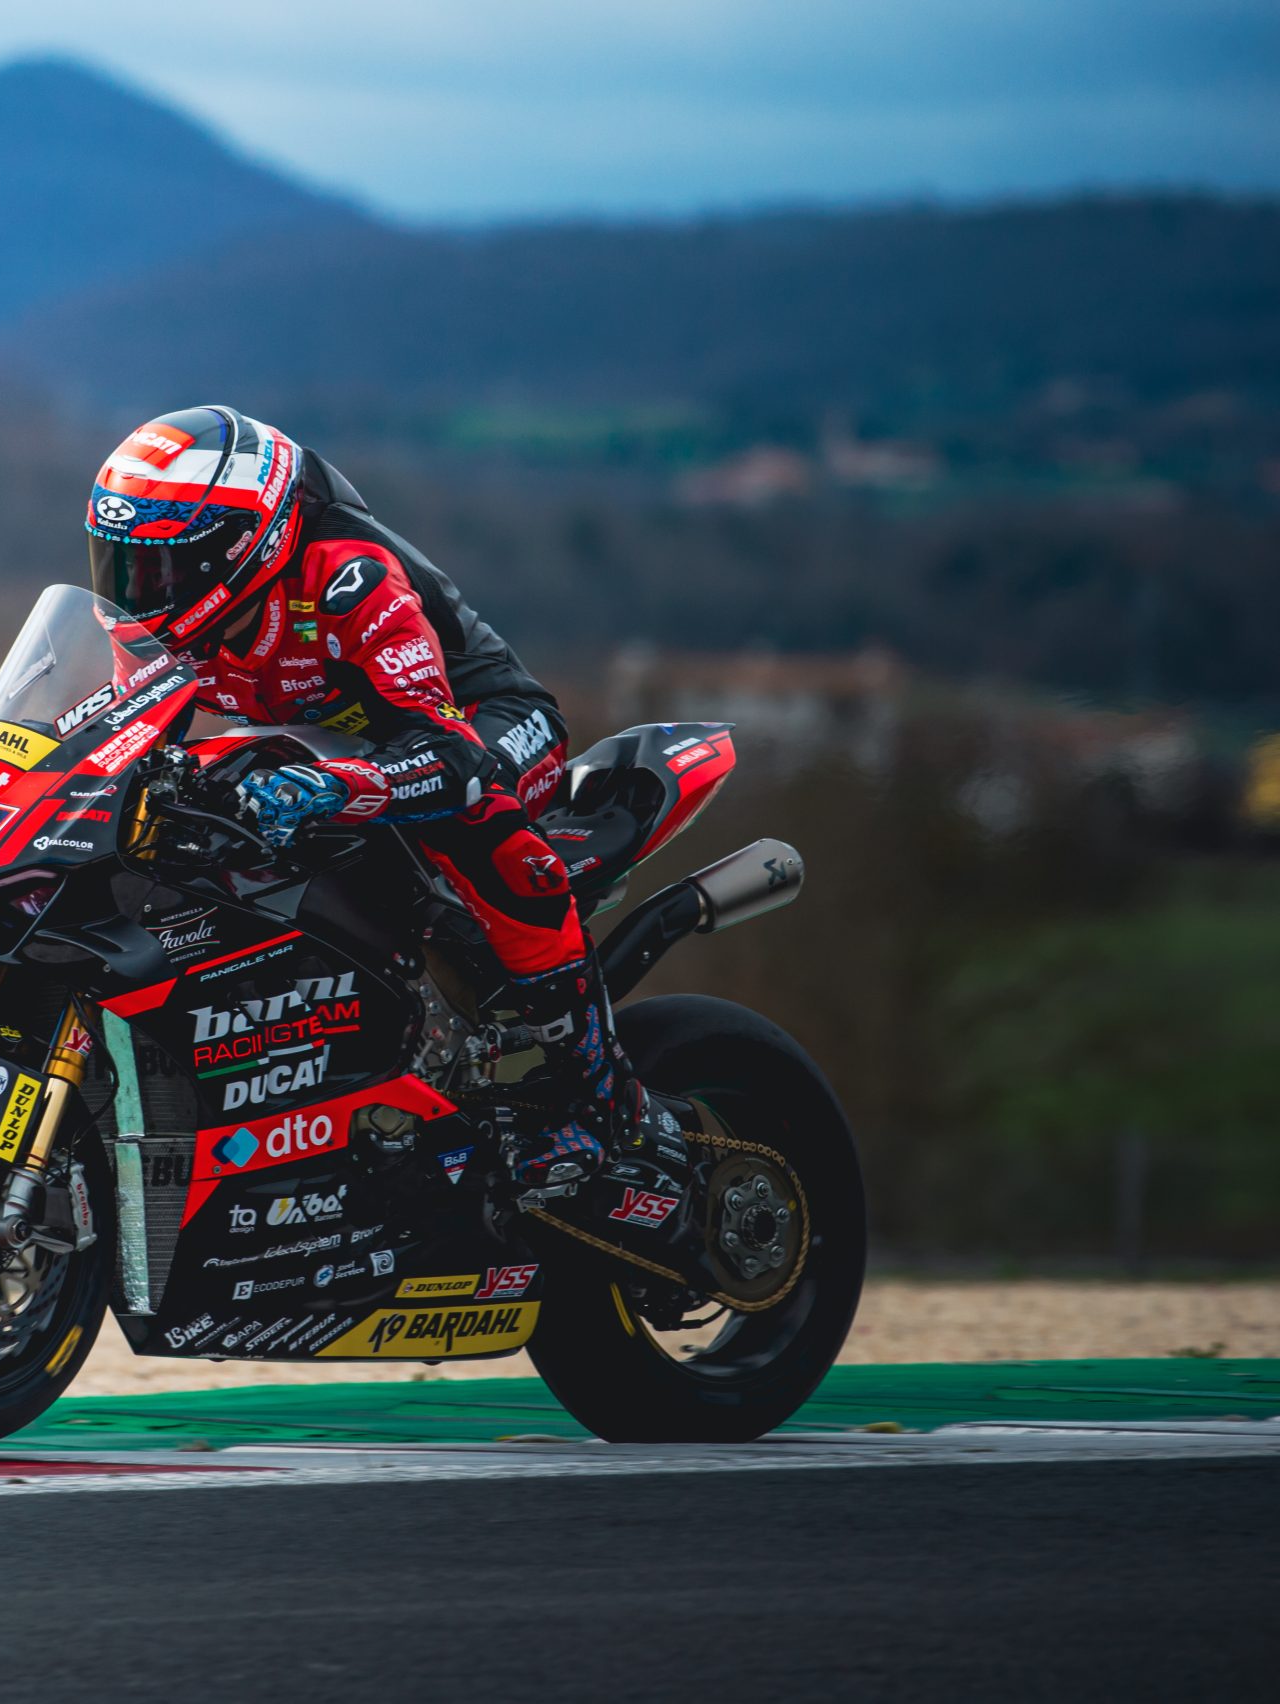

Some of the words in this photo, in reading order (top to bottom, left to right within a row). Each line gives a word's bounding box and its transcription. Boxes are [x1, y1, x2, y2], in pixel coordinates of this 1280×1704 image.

[174, 588, 227, 635] DUCATI
[55, 684, 113, 736] WRS
[158, 919, 212, 949] Favola
[200, 954, 266, 983] PANIGALE
[267, 944, 295, 959] V4R
[266, 1115, 333, 1158] dto
[609, 1187, 679, 1222] YSS
[253, 1276, 306, 1293] ECODEPUR
[414, 1281, 473, 1292] DUNLOP
[474, 1264, 539, 1299] YSS
[404, 1307, 523, 1353] BARDAHL
